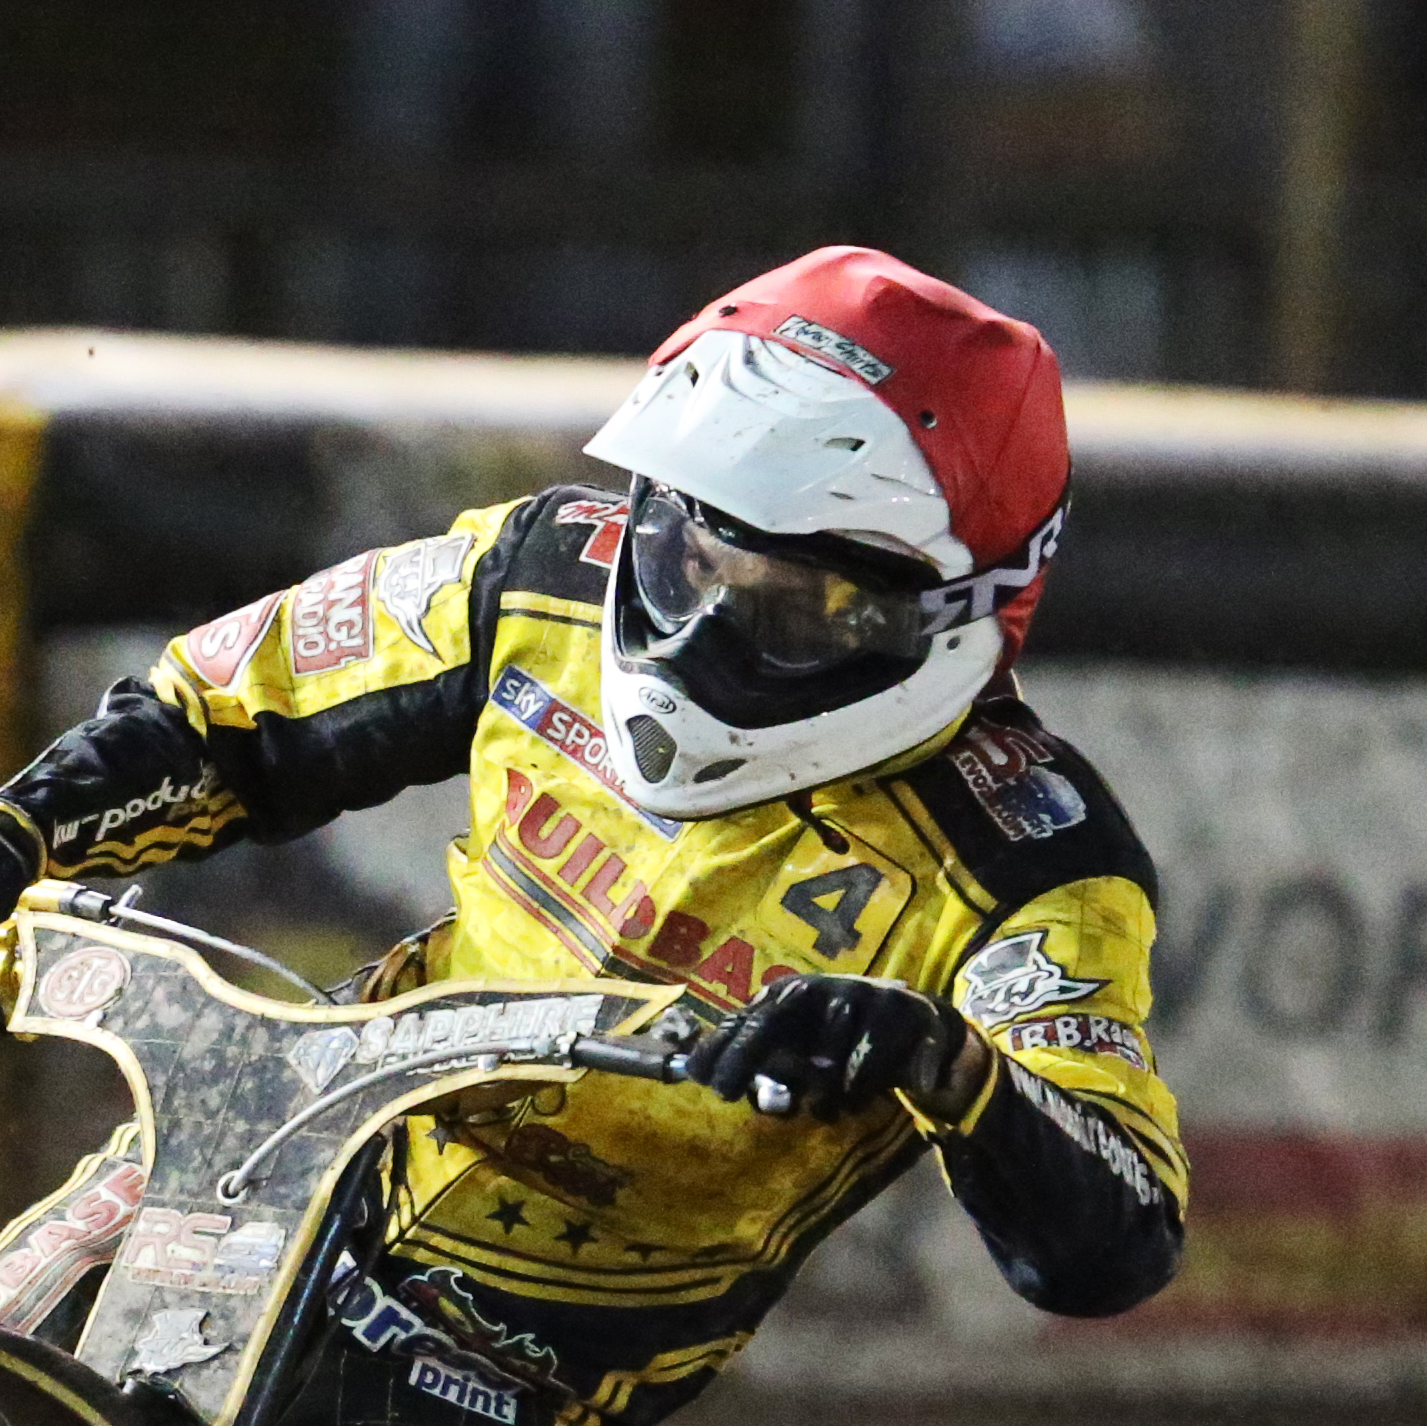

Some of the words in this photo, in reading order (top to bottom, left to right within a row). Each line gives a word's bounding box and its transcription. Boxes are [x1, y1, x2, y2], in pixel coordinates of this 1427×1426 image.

[546, 711, 626, 786] SPOR
[779, 861, 888, 960] 4
[354, 994, 604, 1065] SAPPHIRE
[418, 1360, 514, 1421] print
